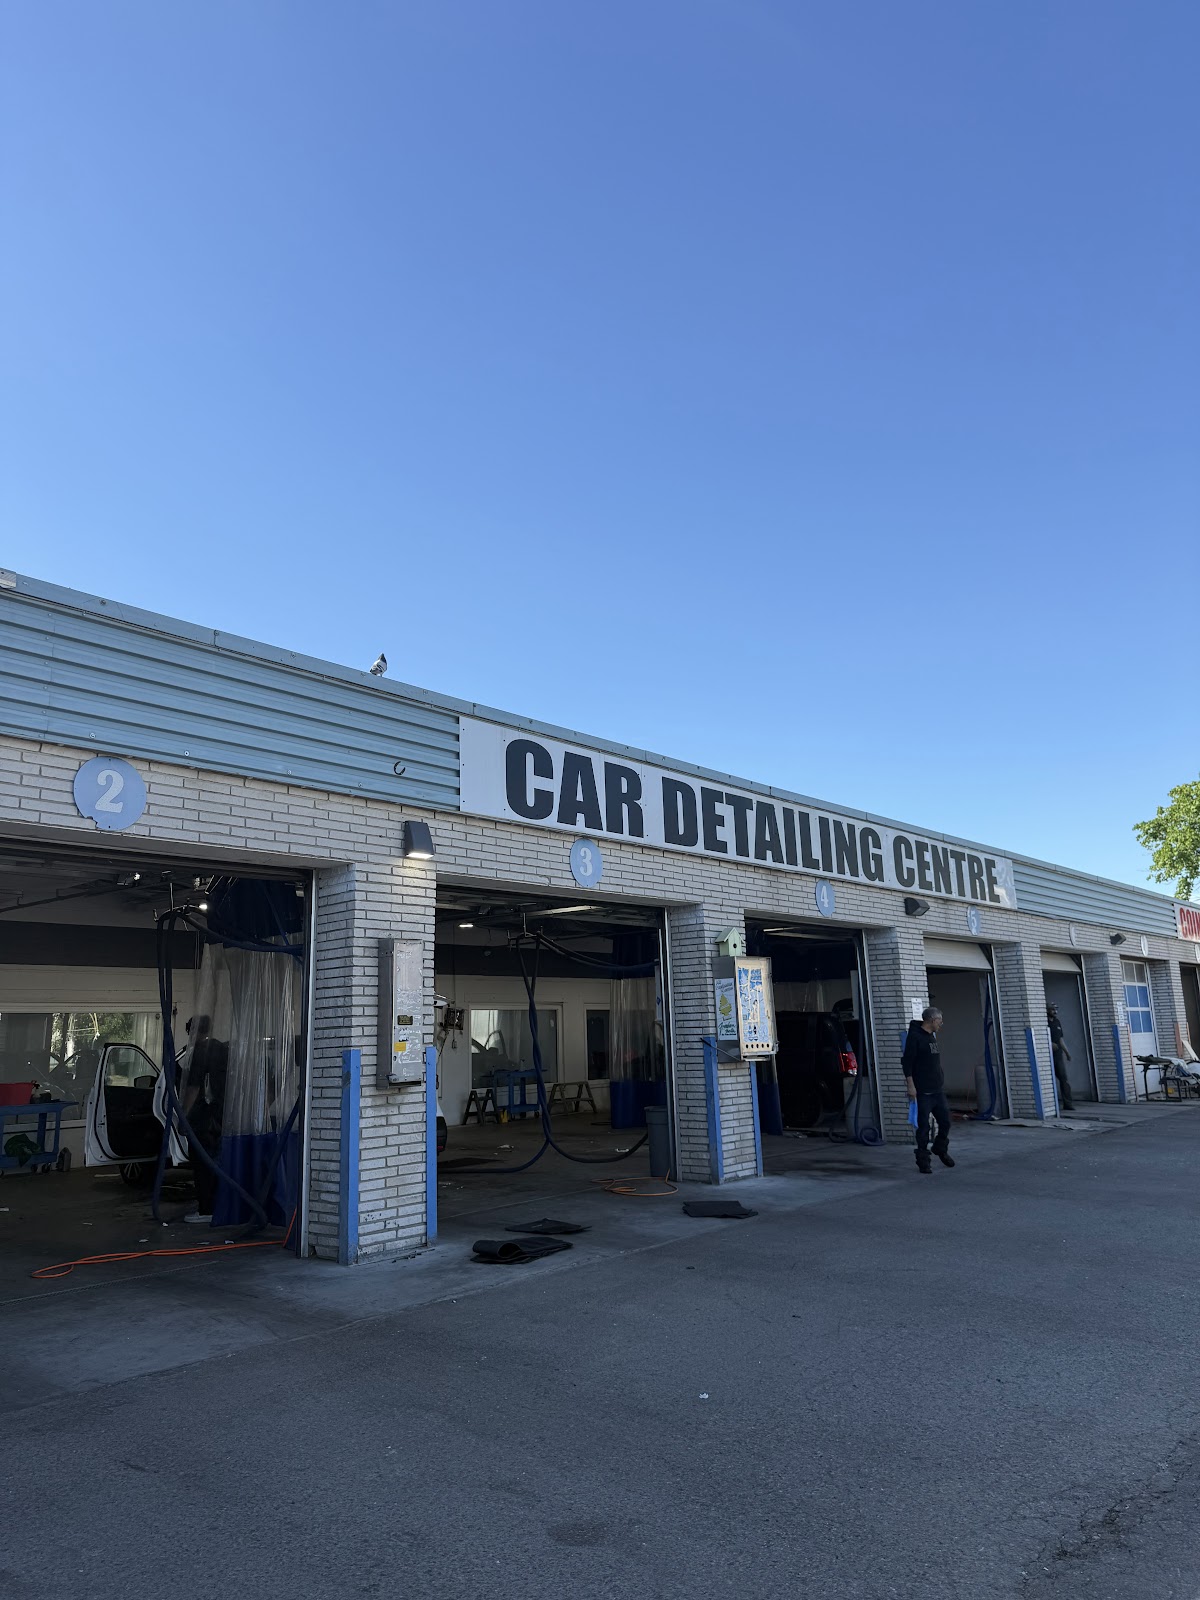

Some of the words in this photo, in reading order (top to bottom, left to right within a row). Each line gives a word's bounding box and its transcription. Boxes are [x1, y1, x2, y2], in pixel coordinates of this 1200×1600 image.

[94, 769, 124, 813] 2
[505, 738, 644, 839] CAR
[661, 776, 885, 883] DETAILING
[892, 834, 1001, 904] CENTRE
[580, 847, 593, 877] 3
[820, 885, 829, 907] 4
[970, 910, 977, 928] 5
